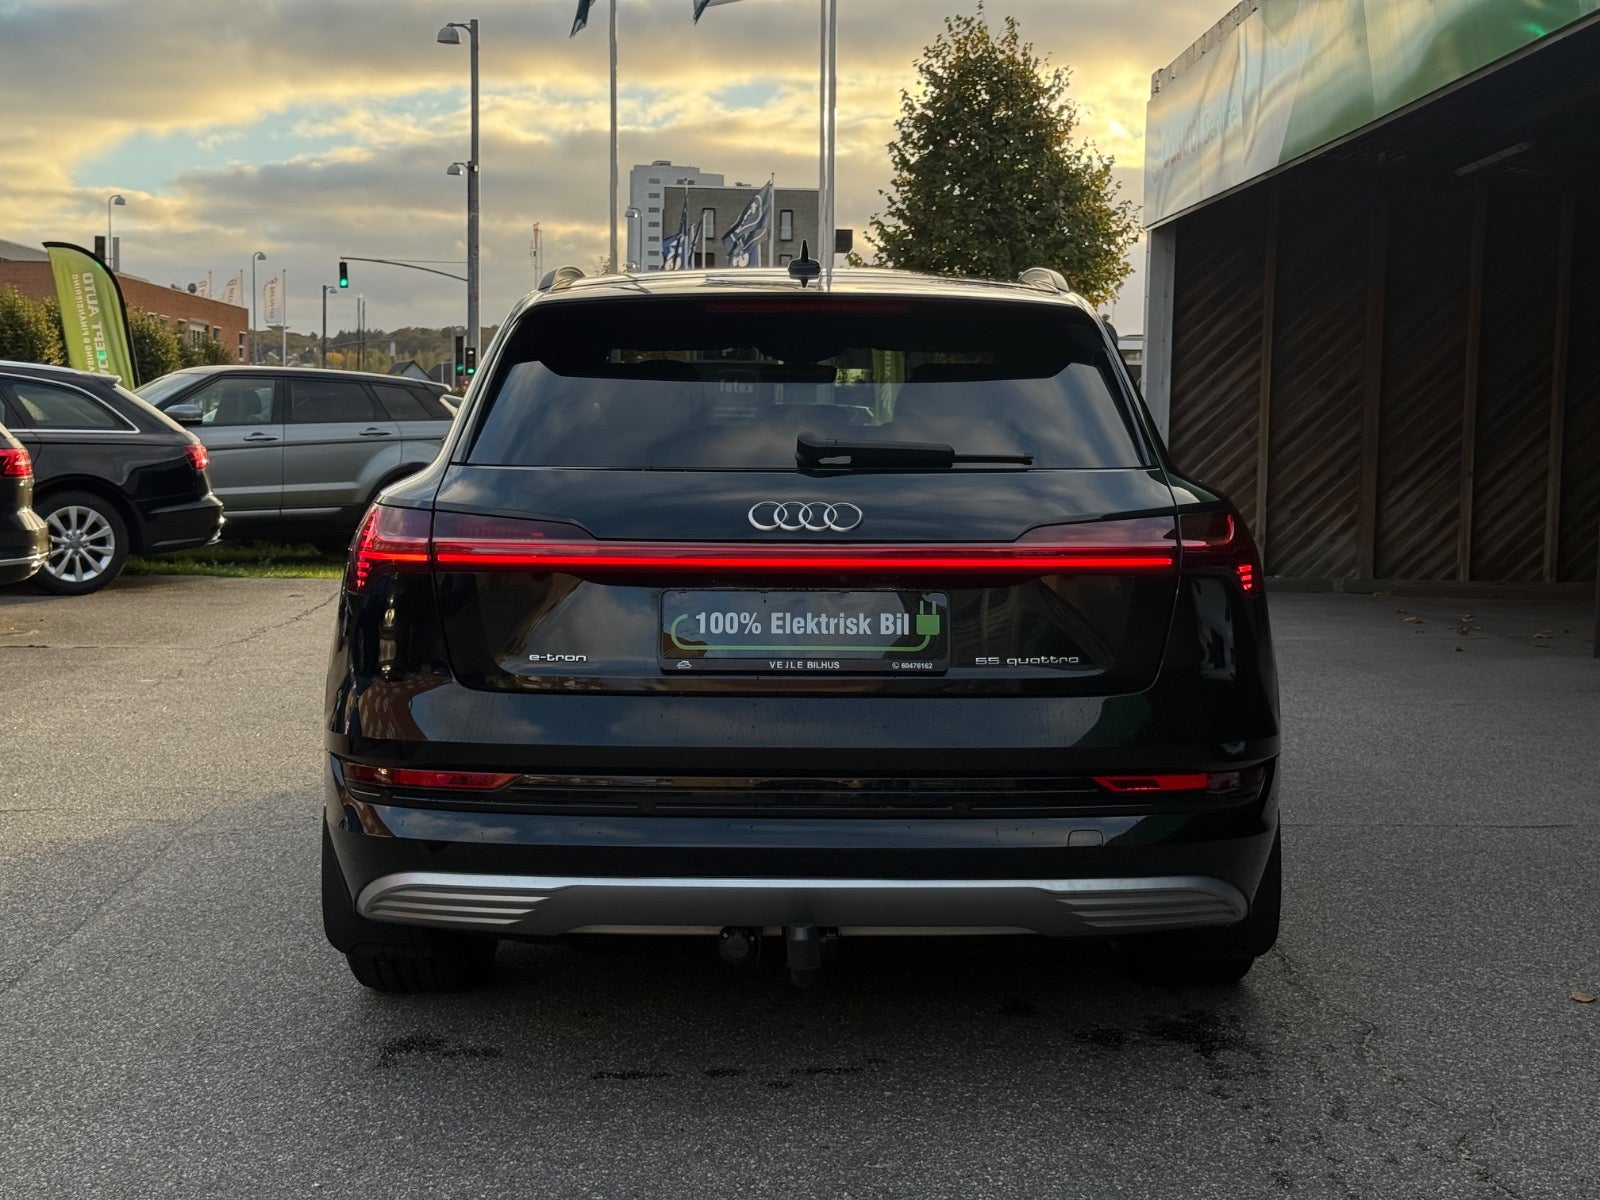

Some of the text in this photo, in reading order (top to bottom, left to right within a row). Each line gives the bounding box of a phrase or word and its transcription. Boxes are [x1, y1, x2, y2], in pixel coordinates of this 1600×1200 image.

[695, 611, 909, 635] 100% Elektrisk Bil
[529, 653, 586, 661] e-tron
[975, 655, 1079, 666] 55 quattro
[807, 661, 840, 670] BILHUS
